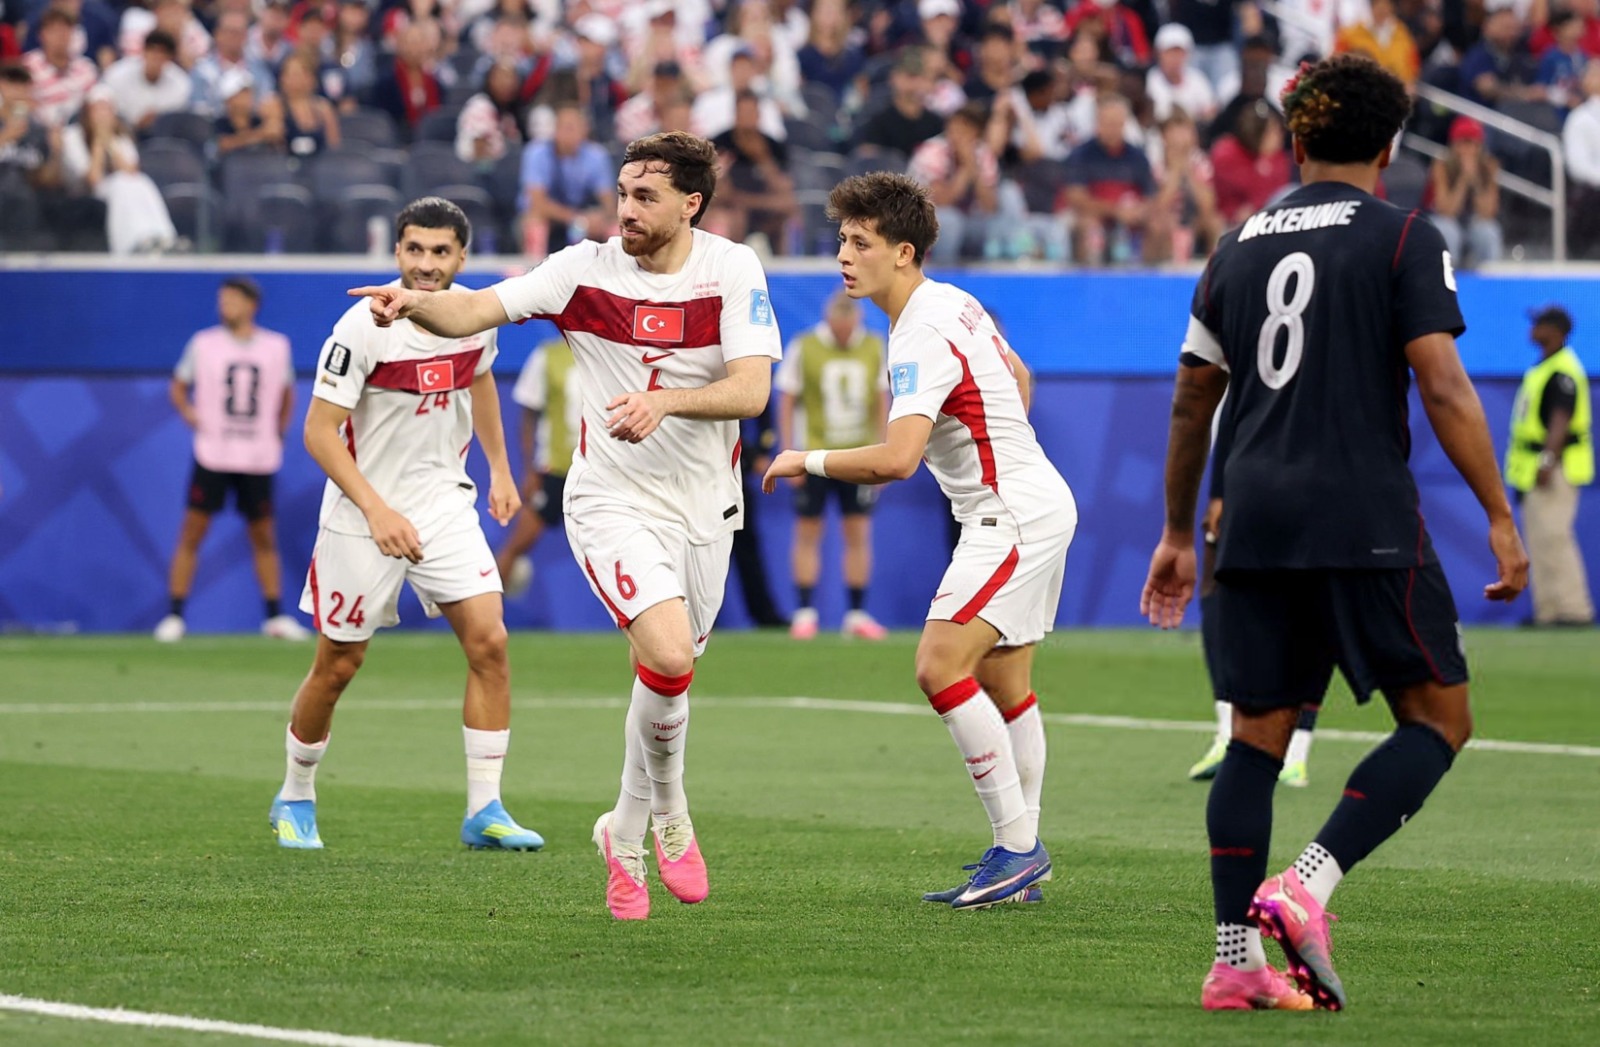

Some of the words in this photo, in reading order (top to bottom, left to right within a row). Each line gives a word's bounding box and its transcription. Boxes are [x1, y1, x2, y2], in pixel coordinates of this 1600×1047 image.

[1237, 201, 1362, 242] McKENNIE
[1257, 252, 1315, 389] 8
[415, 392, 450, 416] 24
[614, 559, 639, 601] 6
[327, 591, 364, 629] 24
